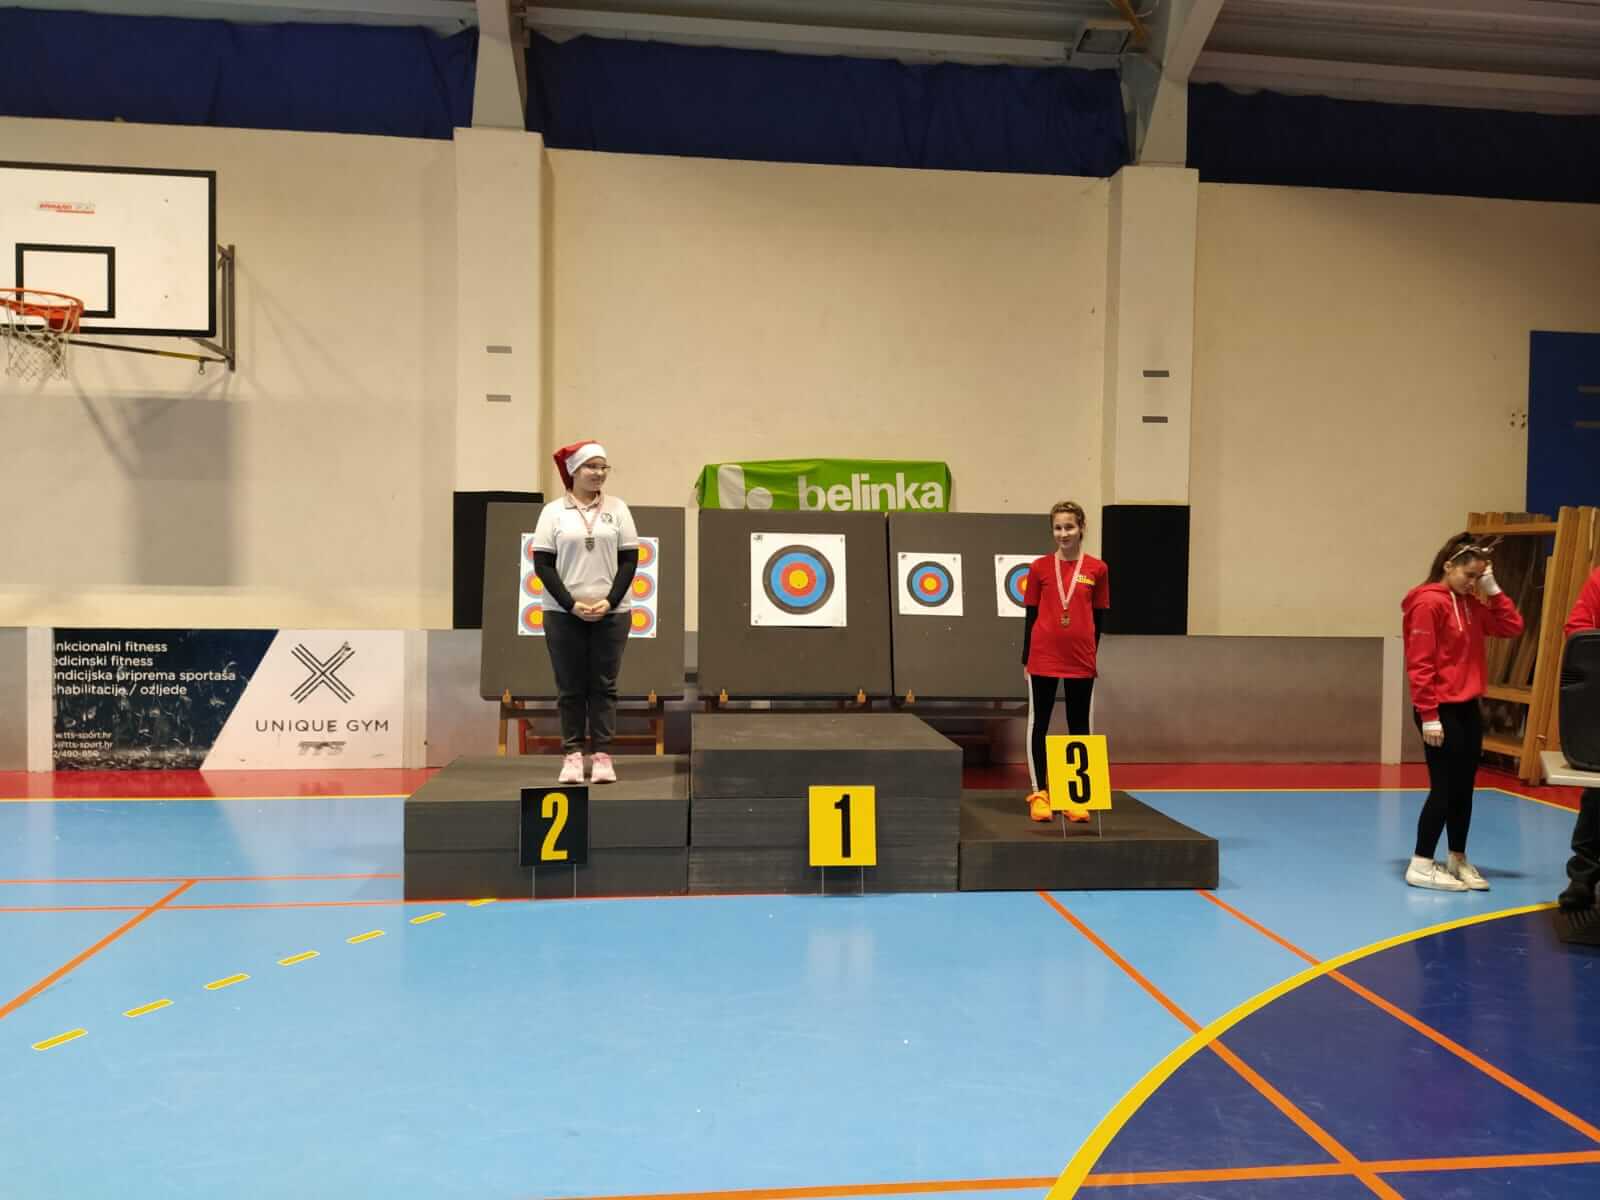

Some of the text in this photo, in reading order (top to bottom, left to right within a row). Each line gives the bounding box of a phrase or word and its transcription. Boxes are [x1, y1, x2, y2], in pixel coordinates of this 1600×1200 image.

[798, 473, 944, 512] belinka
[125, 641, 168, 652] fitness
[112, 655, 154, 667] fitness
[53, 684, 128, 696] habilitacije
[255, 719, 389, 733] UNIQUE GYM
[1066, 741, 1090, 804] 3
[541, 793, 569, 860] 2
[834, 795, 851, 858] 1
